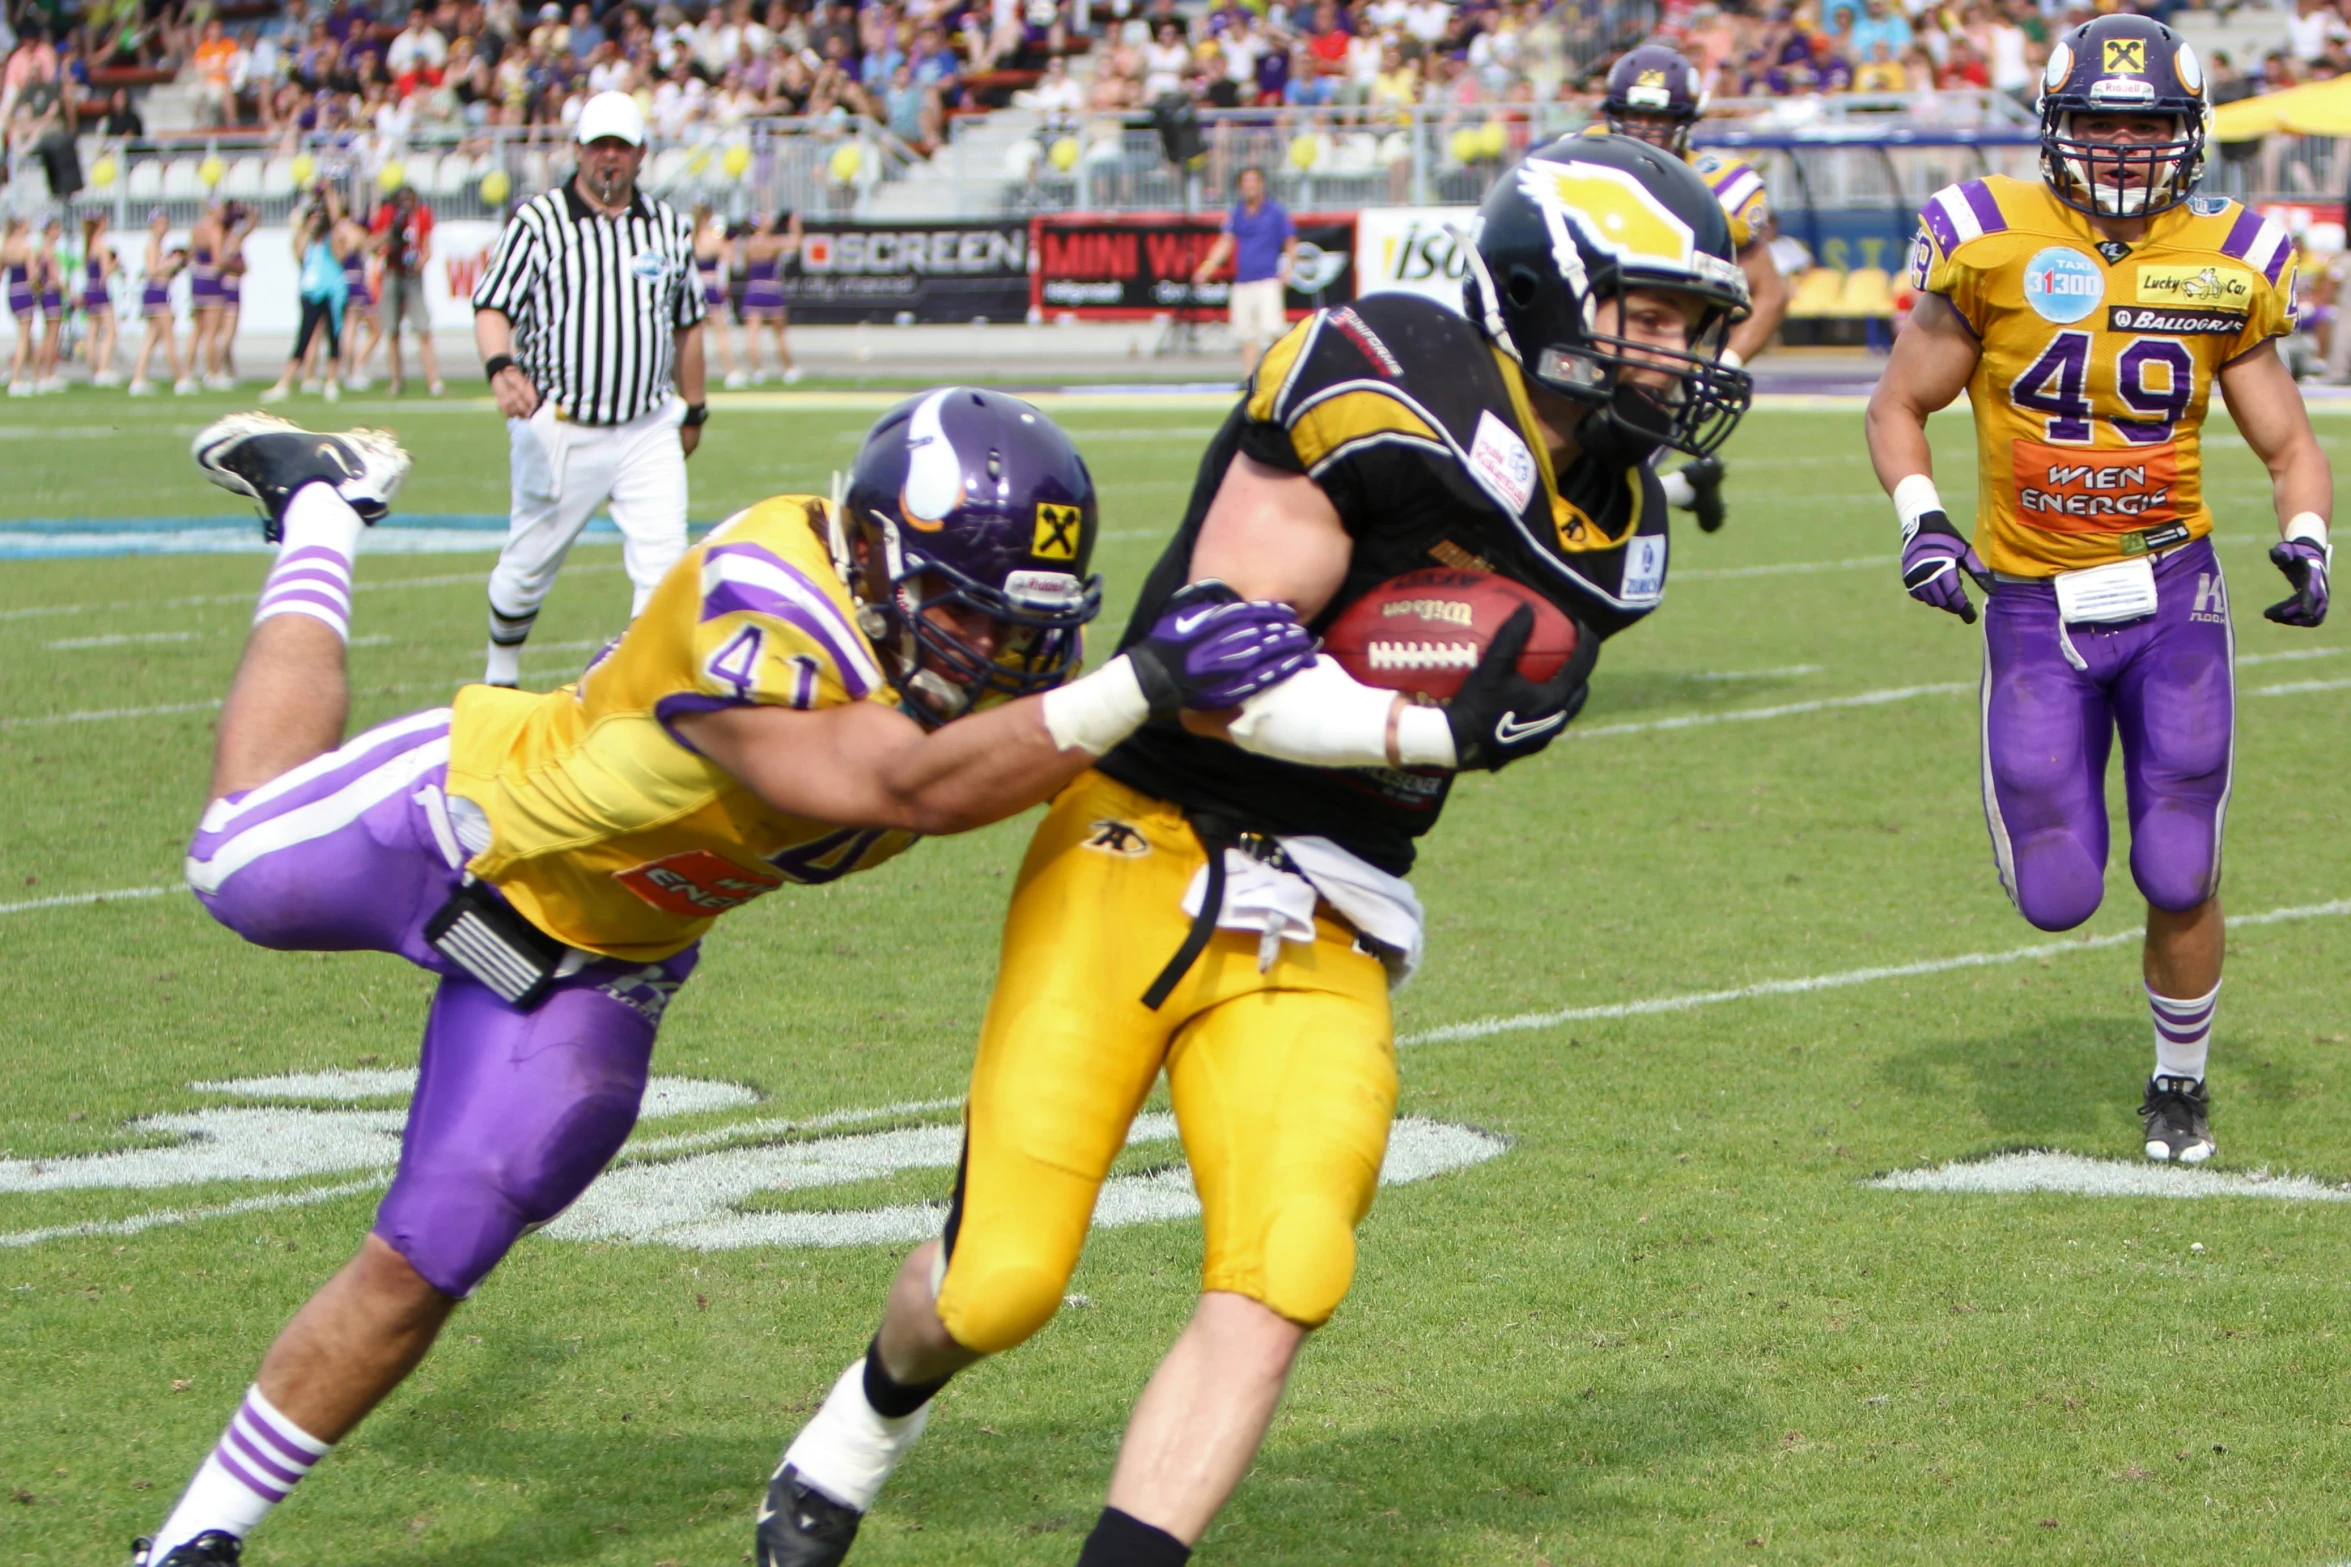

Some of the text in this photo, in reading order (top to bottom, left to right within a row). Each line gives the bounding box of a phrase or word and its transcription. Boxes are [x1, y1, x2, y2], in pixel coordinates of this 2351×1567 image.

[1045, 231, 1138, 279] MINI
[2056, 259, 2092, 271] TAXI
[2027, 268, 2100, 296] 31300
[2143, 275, 2247, 295] Lucky Car
[2009, 328, 2195, 446] 49
[2048, 463, 2145, 489] WIEN
[2020, 487, 2170, 516] ENERGIE
[1382, 599, 1473, 627] Wilson
[704, 622, 821, 710] 41
